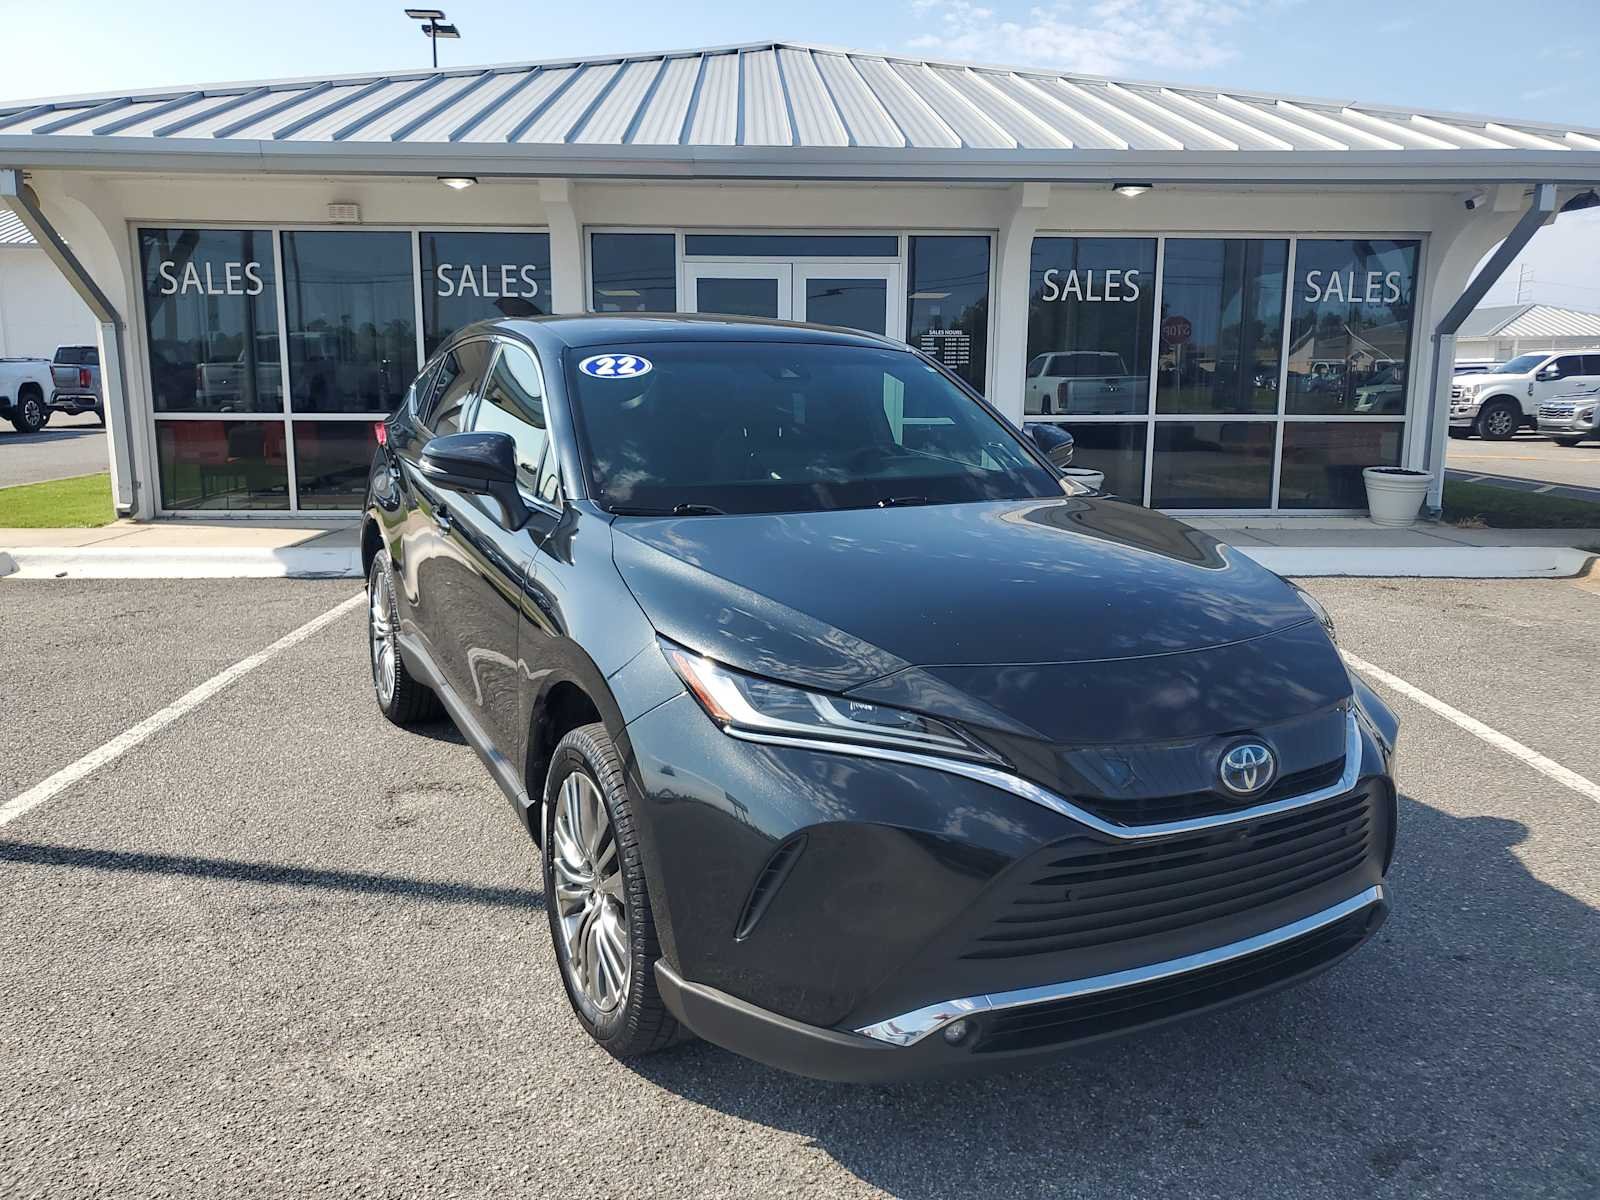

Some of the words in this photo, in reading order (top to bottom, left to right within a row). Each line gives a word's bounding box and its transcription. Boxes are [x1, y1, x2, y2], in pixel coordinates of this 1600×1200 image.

[159, 261, 264, 296] SALES
[437, 263, 538, 298] SALES
[1042, 269, 1140, 302] SALES
[1304, 270, 1401, 303] SALES
[595, 356, 637, 375] 22
